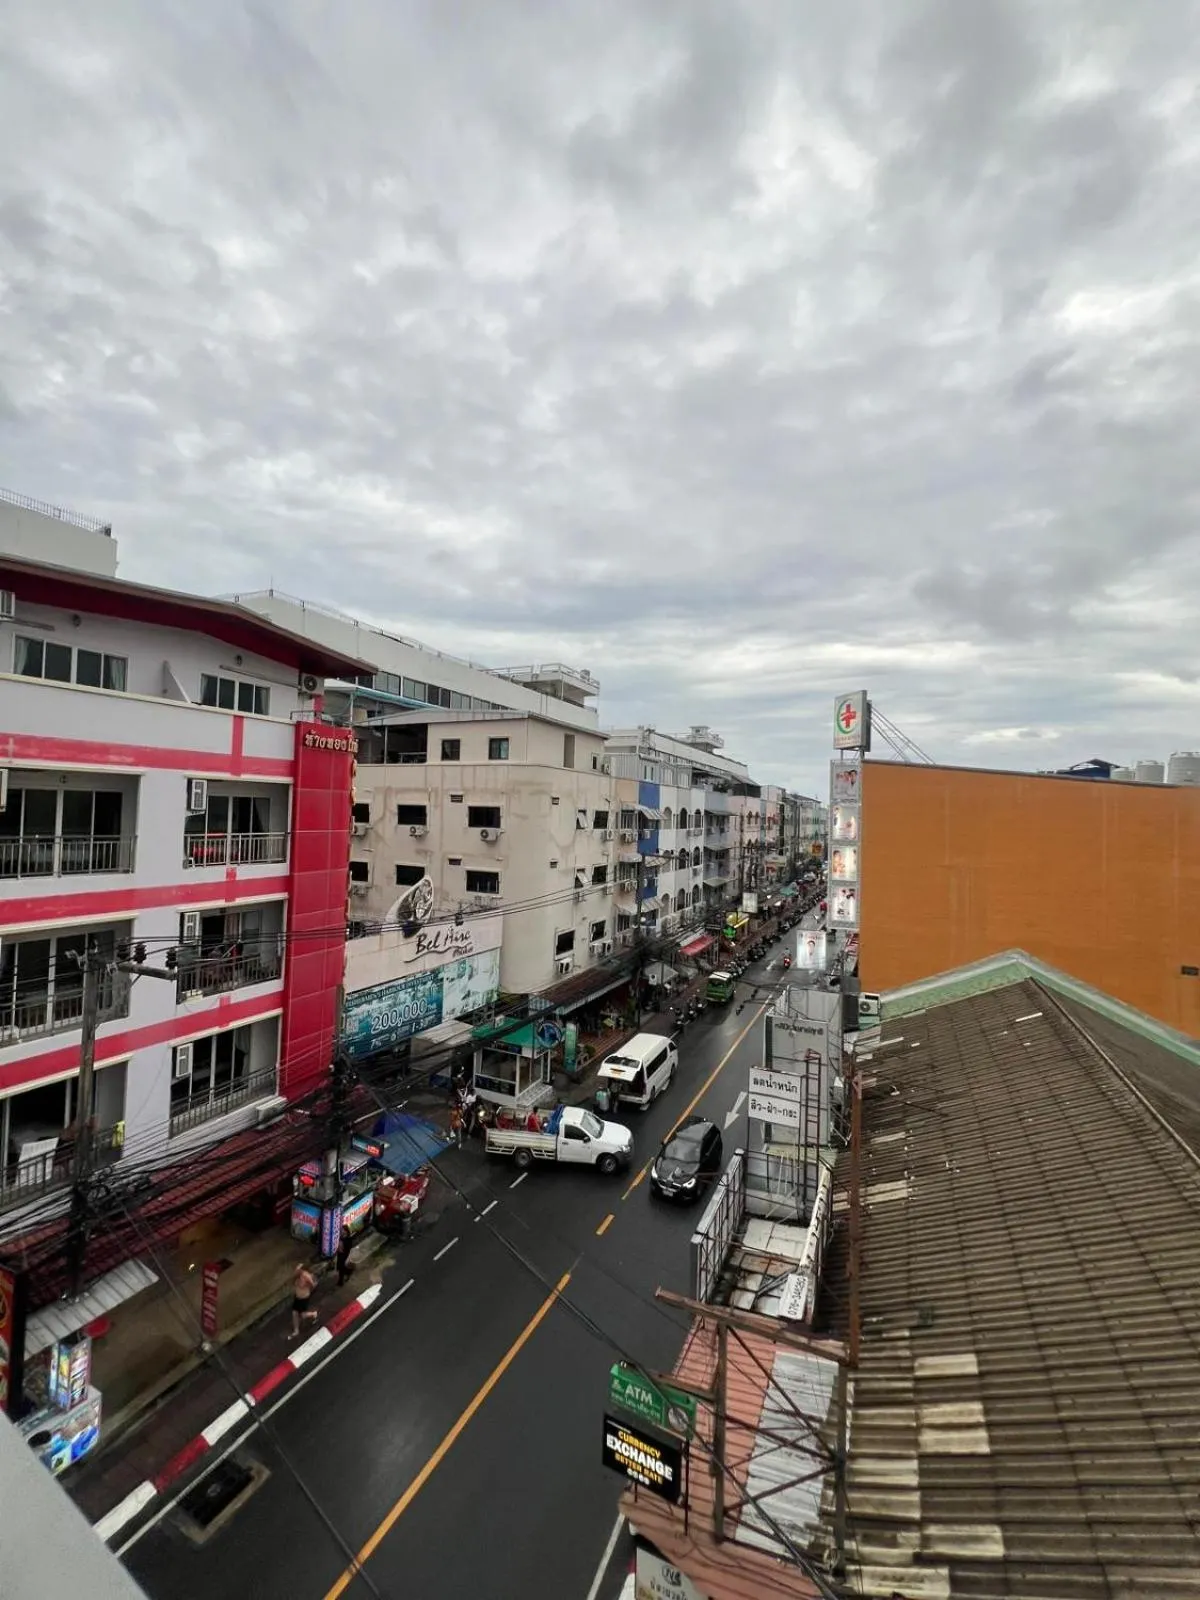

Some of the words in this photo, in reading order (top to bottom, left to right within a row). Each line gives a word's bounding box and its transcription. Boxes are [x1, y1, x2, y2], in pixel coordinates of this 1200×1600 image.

[415, 931, 441, 955] Bel
[370, 1000, 428, 1034] 200,000
[753, 1073, 798, 1094] ลดน้ำหนัก
[625, 1384, 653, 1406] ATM
[606, 1433, 673, 1482] EXCHANGE
[618, 1430, 661, 1459] CURRENCY
